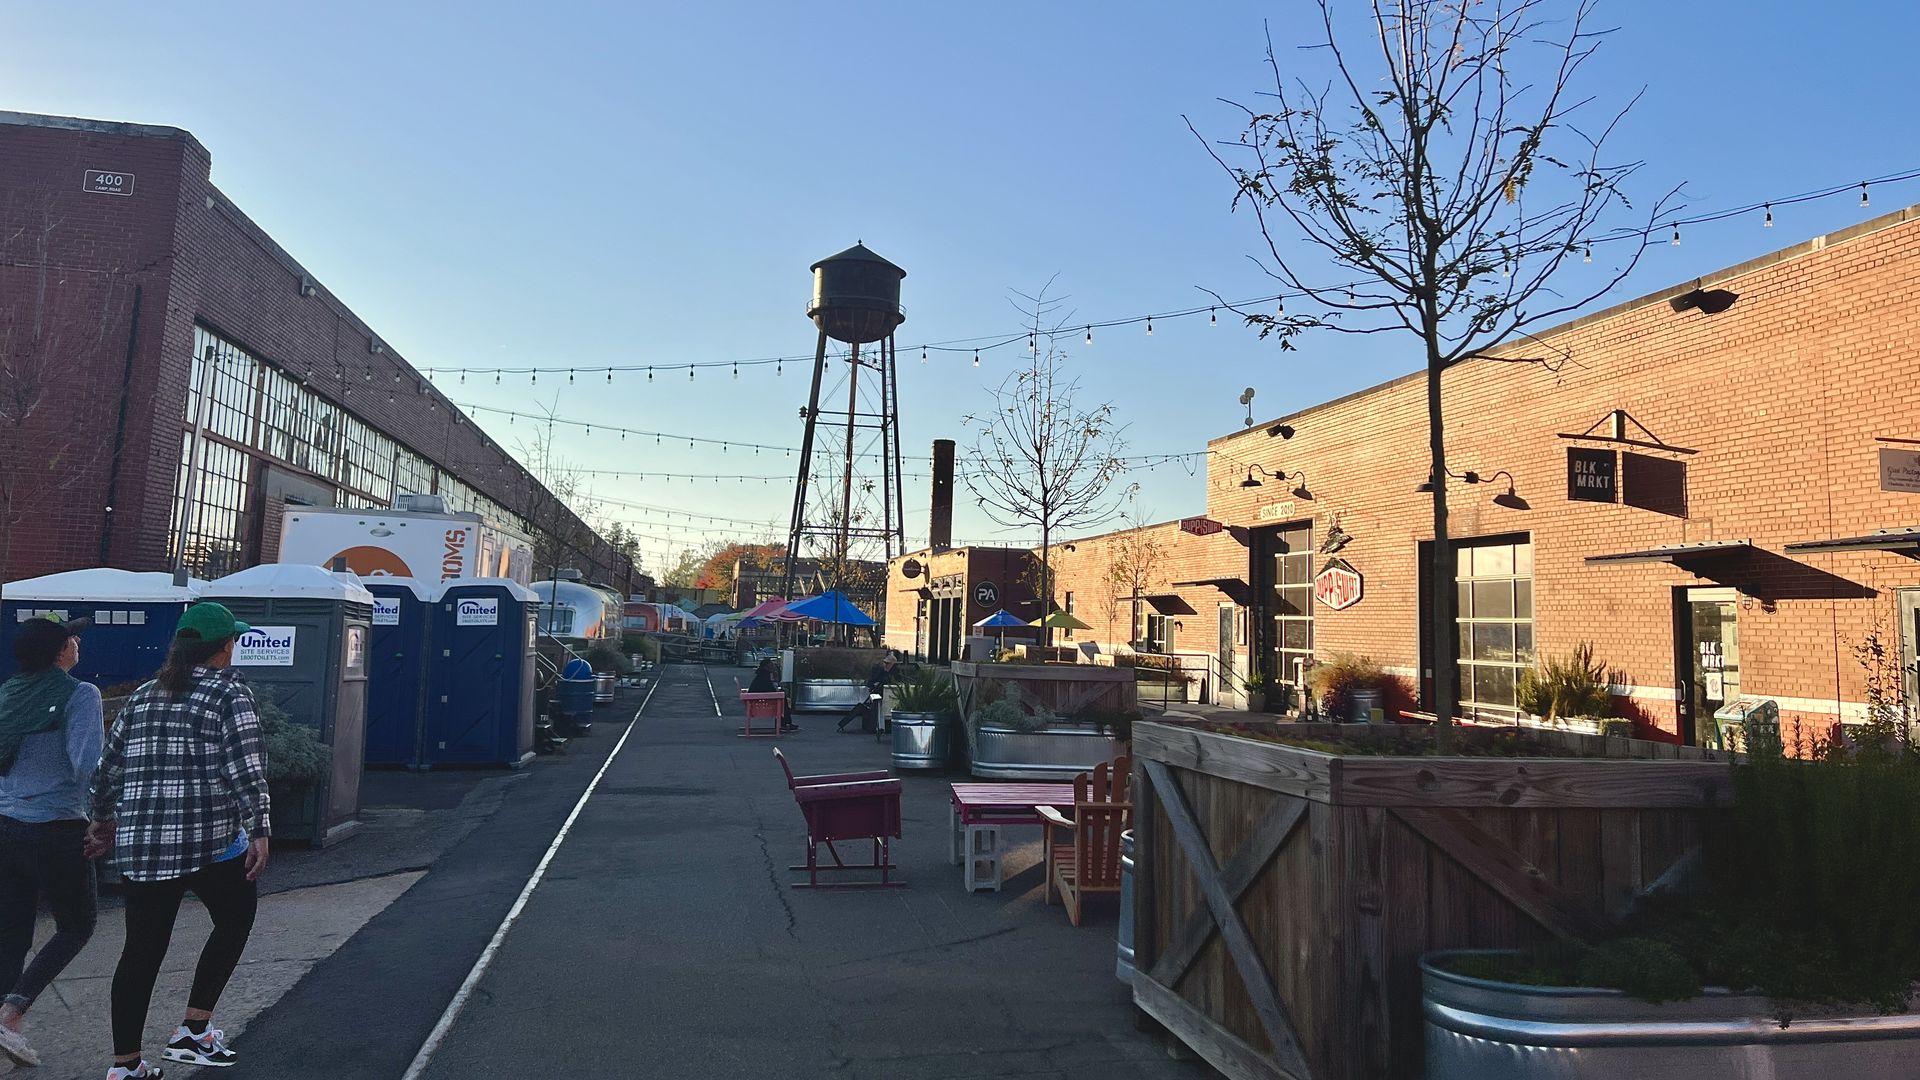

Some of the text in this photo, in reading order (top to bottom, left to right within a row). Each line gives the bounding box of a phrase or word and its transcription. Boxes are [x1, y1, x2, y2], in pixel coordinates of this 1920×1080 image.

[96, 174, 123, 186] 400
[1575, 460, 1597, 474] BLK
[1577, 475, 1610, 489] MRKT
[1262, 503, 1294, 518] SINCE 2010
[978, 588, 996, 601] PA
[373, 605, 398, 614] nited
[462, 605, 497, 615] United
[241, 635, 291, 648] United
[1700, 641, 1716, 655] BLK
[1702, 655, 1725, 668] MRKT
